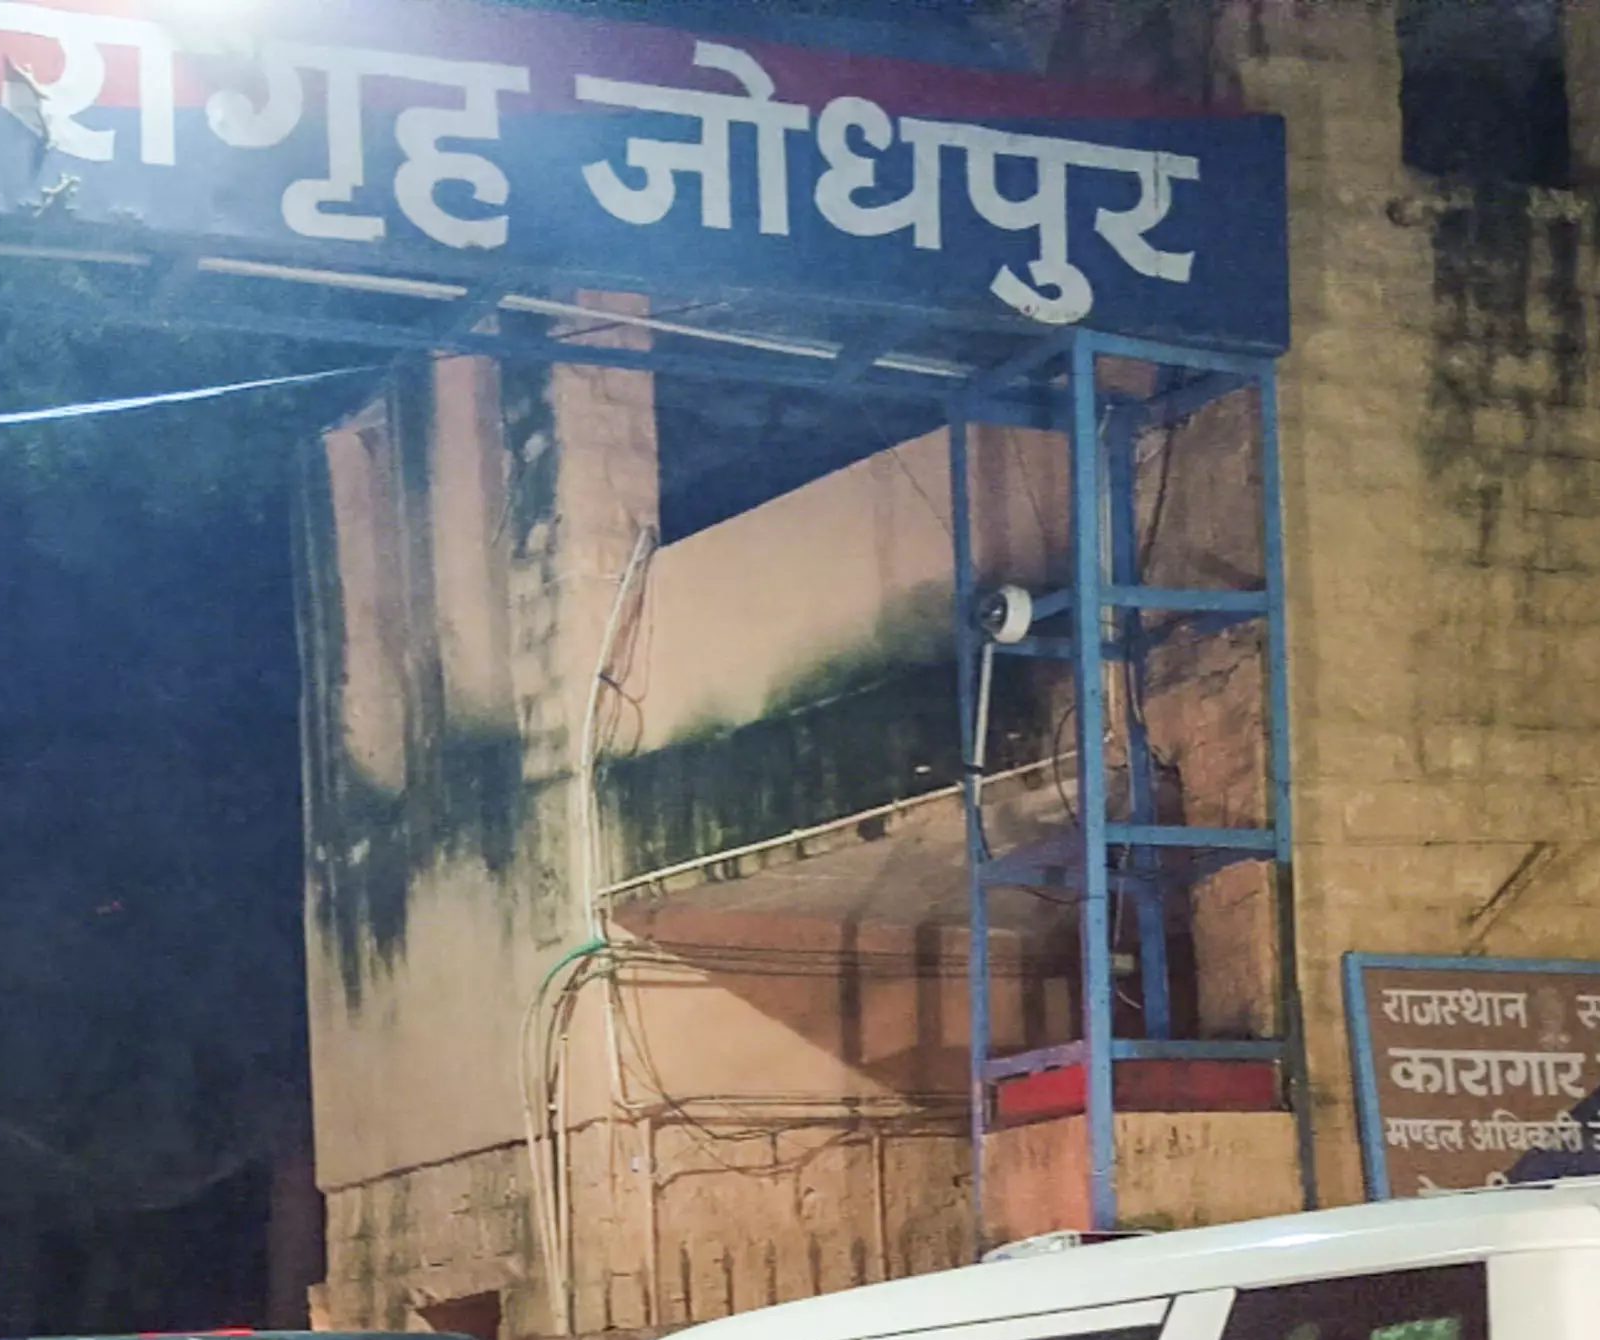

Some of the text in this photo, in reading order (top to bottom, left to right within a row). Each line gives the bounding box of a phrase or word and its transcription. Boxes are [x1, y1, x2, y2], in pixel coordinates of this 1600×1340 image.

[574, 39, 1200, 324] जोधपुर
[1381, 987, 1528, 1029] राजस्थान
[1387, 1047, 1586, 1098] कारागार
[1384, 1116, 1464, 1152] मण्डल
[1471, 1109, 1584, 1153] अधिकारी
